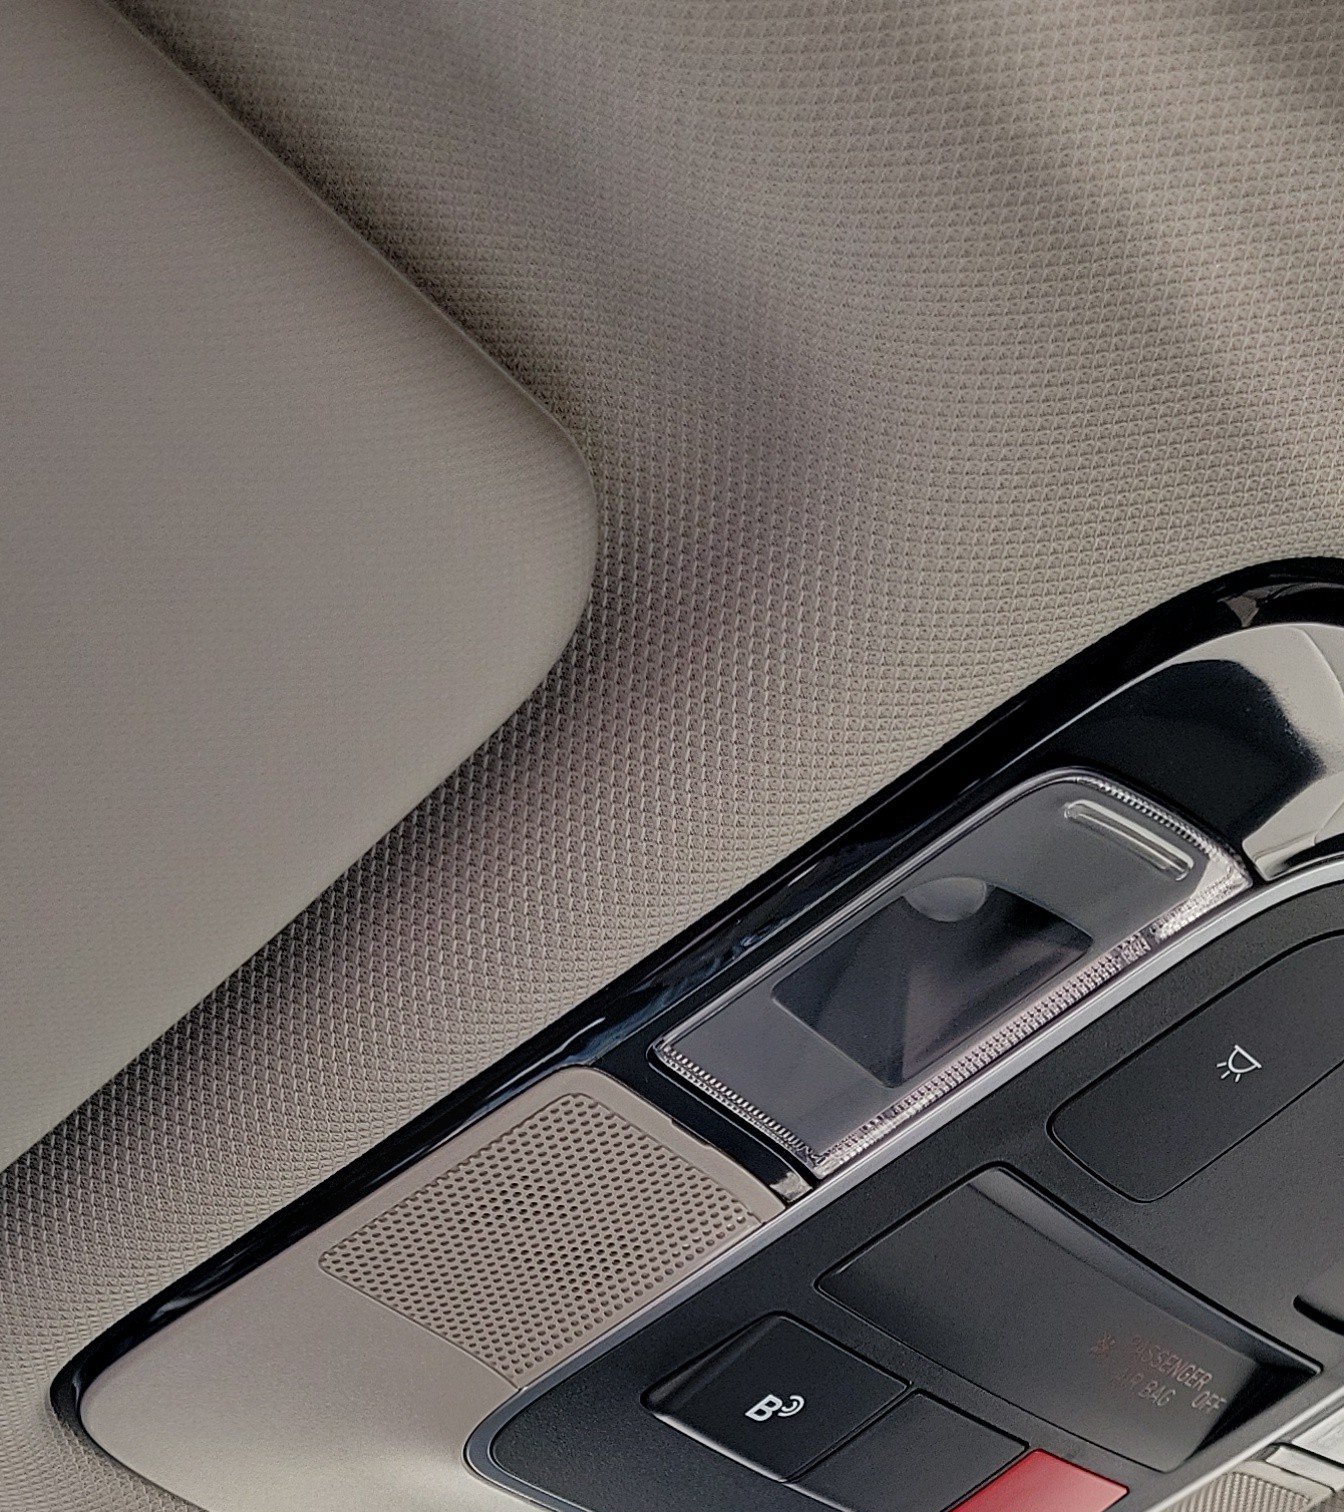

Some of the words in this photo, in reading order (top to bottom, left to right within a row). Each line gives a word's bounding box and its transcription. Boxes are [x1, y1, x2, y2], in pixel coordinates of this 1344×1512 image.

[1130, 1334, 1214, 1392] PASSENGER
[1137, 1379, 1177, 1407] BAG
[1190, 1390, 1228, 1414] OFF
